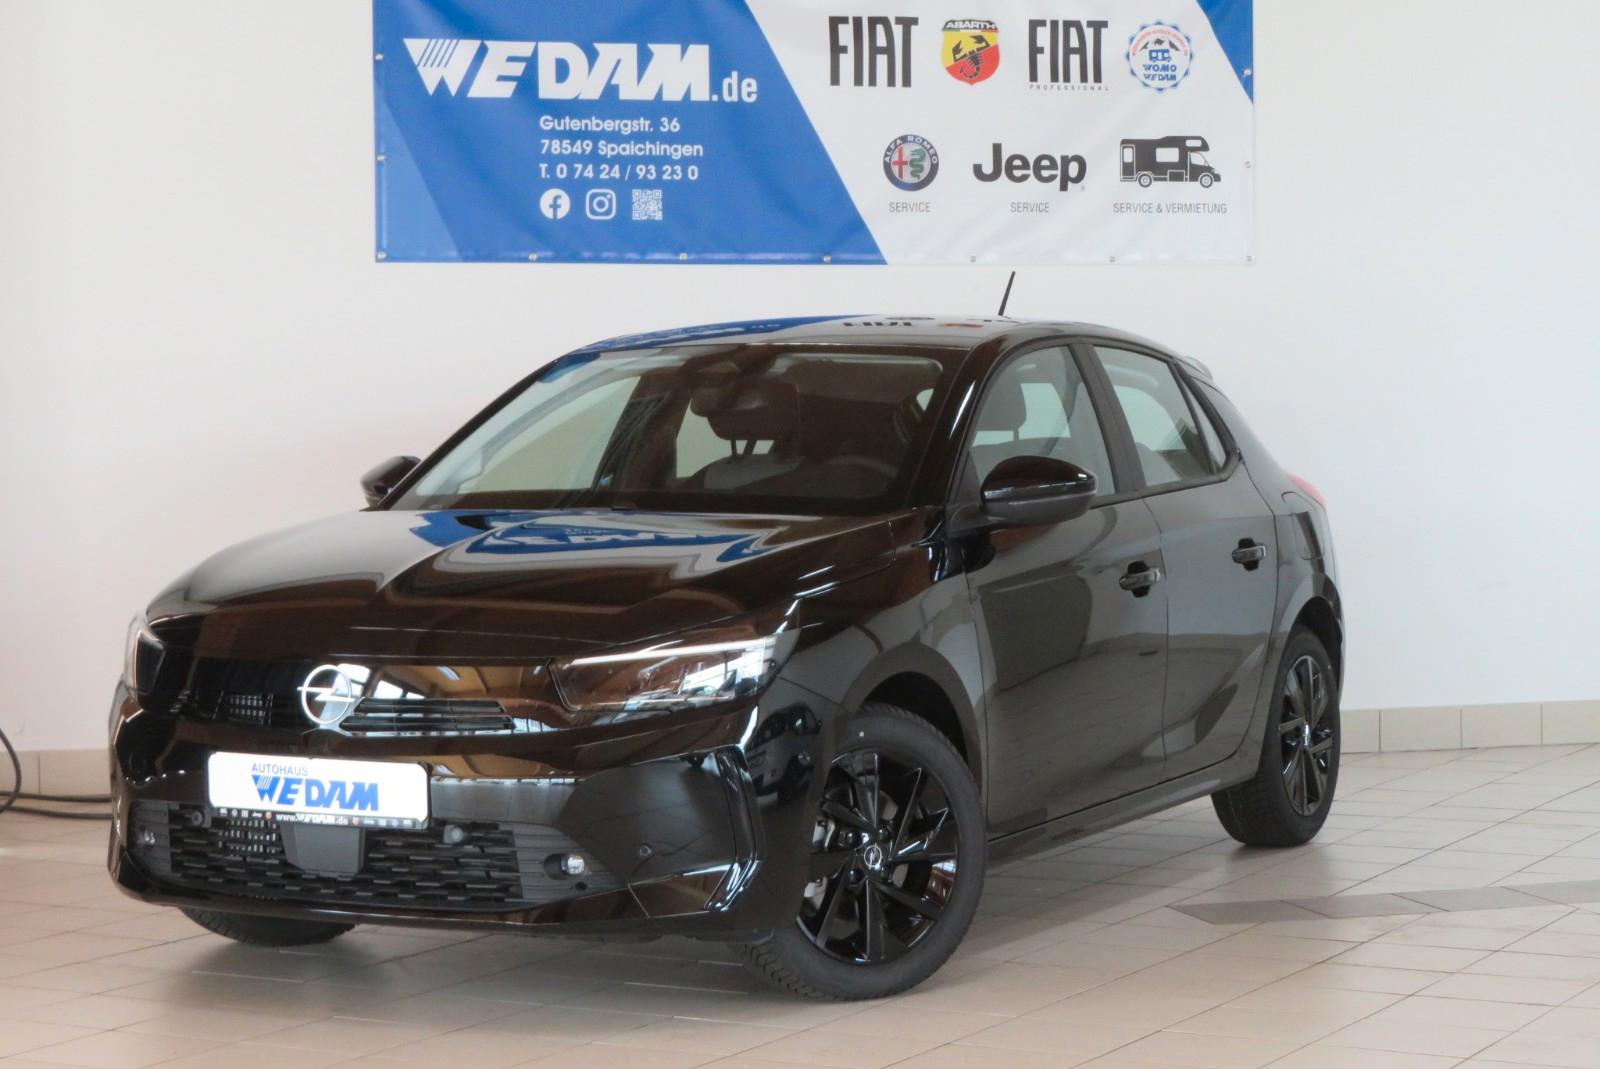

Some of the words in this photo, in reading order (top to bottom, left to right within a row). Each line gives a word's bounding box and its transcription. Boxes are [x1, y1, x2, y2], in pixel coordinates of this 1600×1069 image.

[946, 21, 996, 30] ABARTH
[828, 16, 919, 88] FIAT
[1028, 19, 1109, 84] FIAT
[1143, 64, 1177, 73] WOMO
[1029, 84, 1110, 92] PROFESSIONAL
[539, 115, 654, 135] Gutenbergstr.
[659, 117, 680, 132] 36
[540, 139, 593, 155] 78549
[598, 140, 704, 159] Spaichingen
[884, 138, 903, 163] ALFA
[907, 135, 938, 164] ROMEO
[539, 164, 551, 179] T.
[556, 164, 567, 179] 0
[573, 164, 594, 179] 74
[599, 164, 621, 180] 24
[636, 165, 657, 180] 93
[662, 165, 683, 180] 23
[688, 165, 699, 180] 0
[972, 143, 1087, 192] Jeep
[889, 202, 931, 213] SERVICE
[1010, 202, 1049, 213] SERVICE
[1113, 202, 1153, 214] SERVICE
[1155, 203, 1163, 214] &
[1165, 203, 1227, 214] VERMIETUNG
[251, 762, 309, 776] AUTOHAUS
[251, 774, 379, 812] WEDAM
